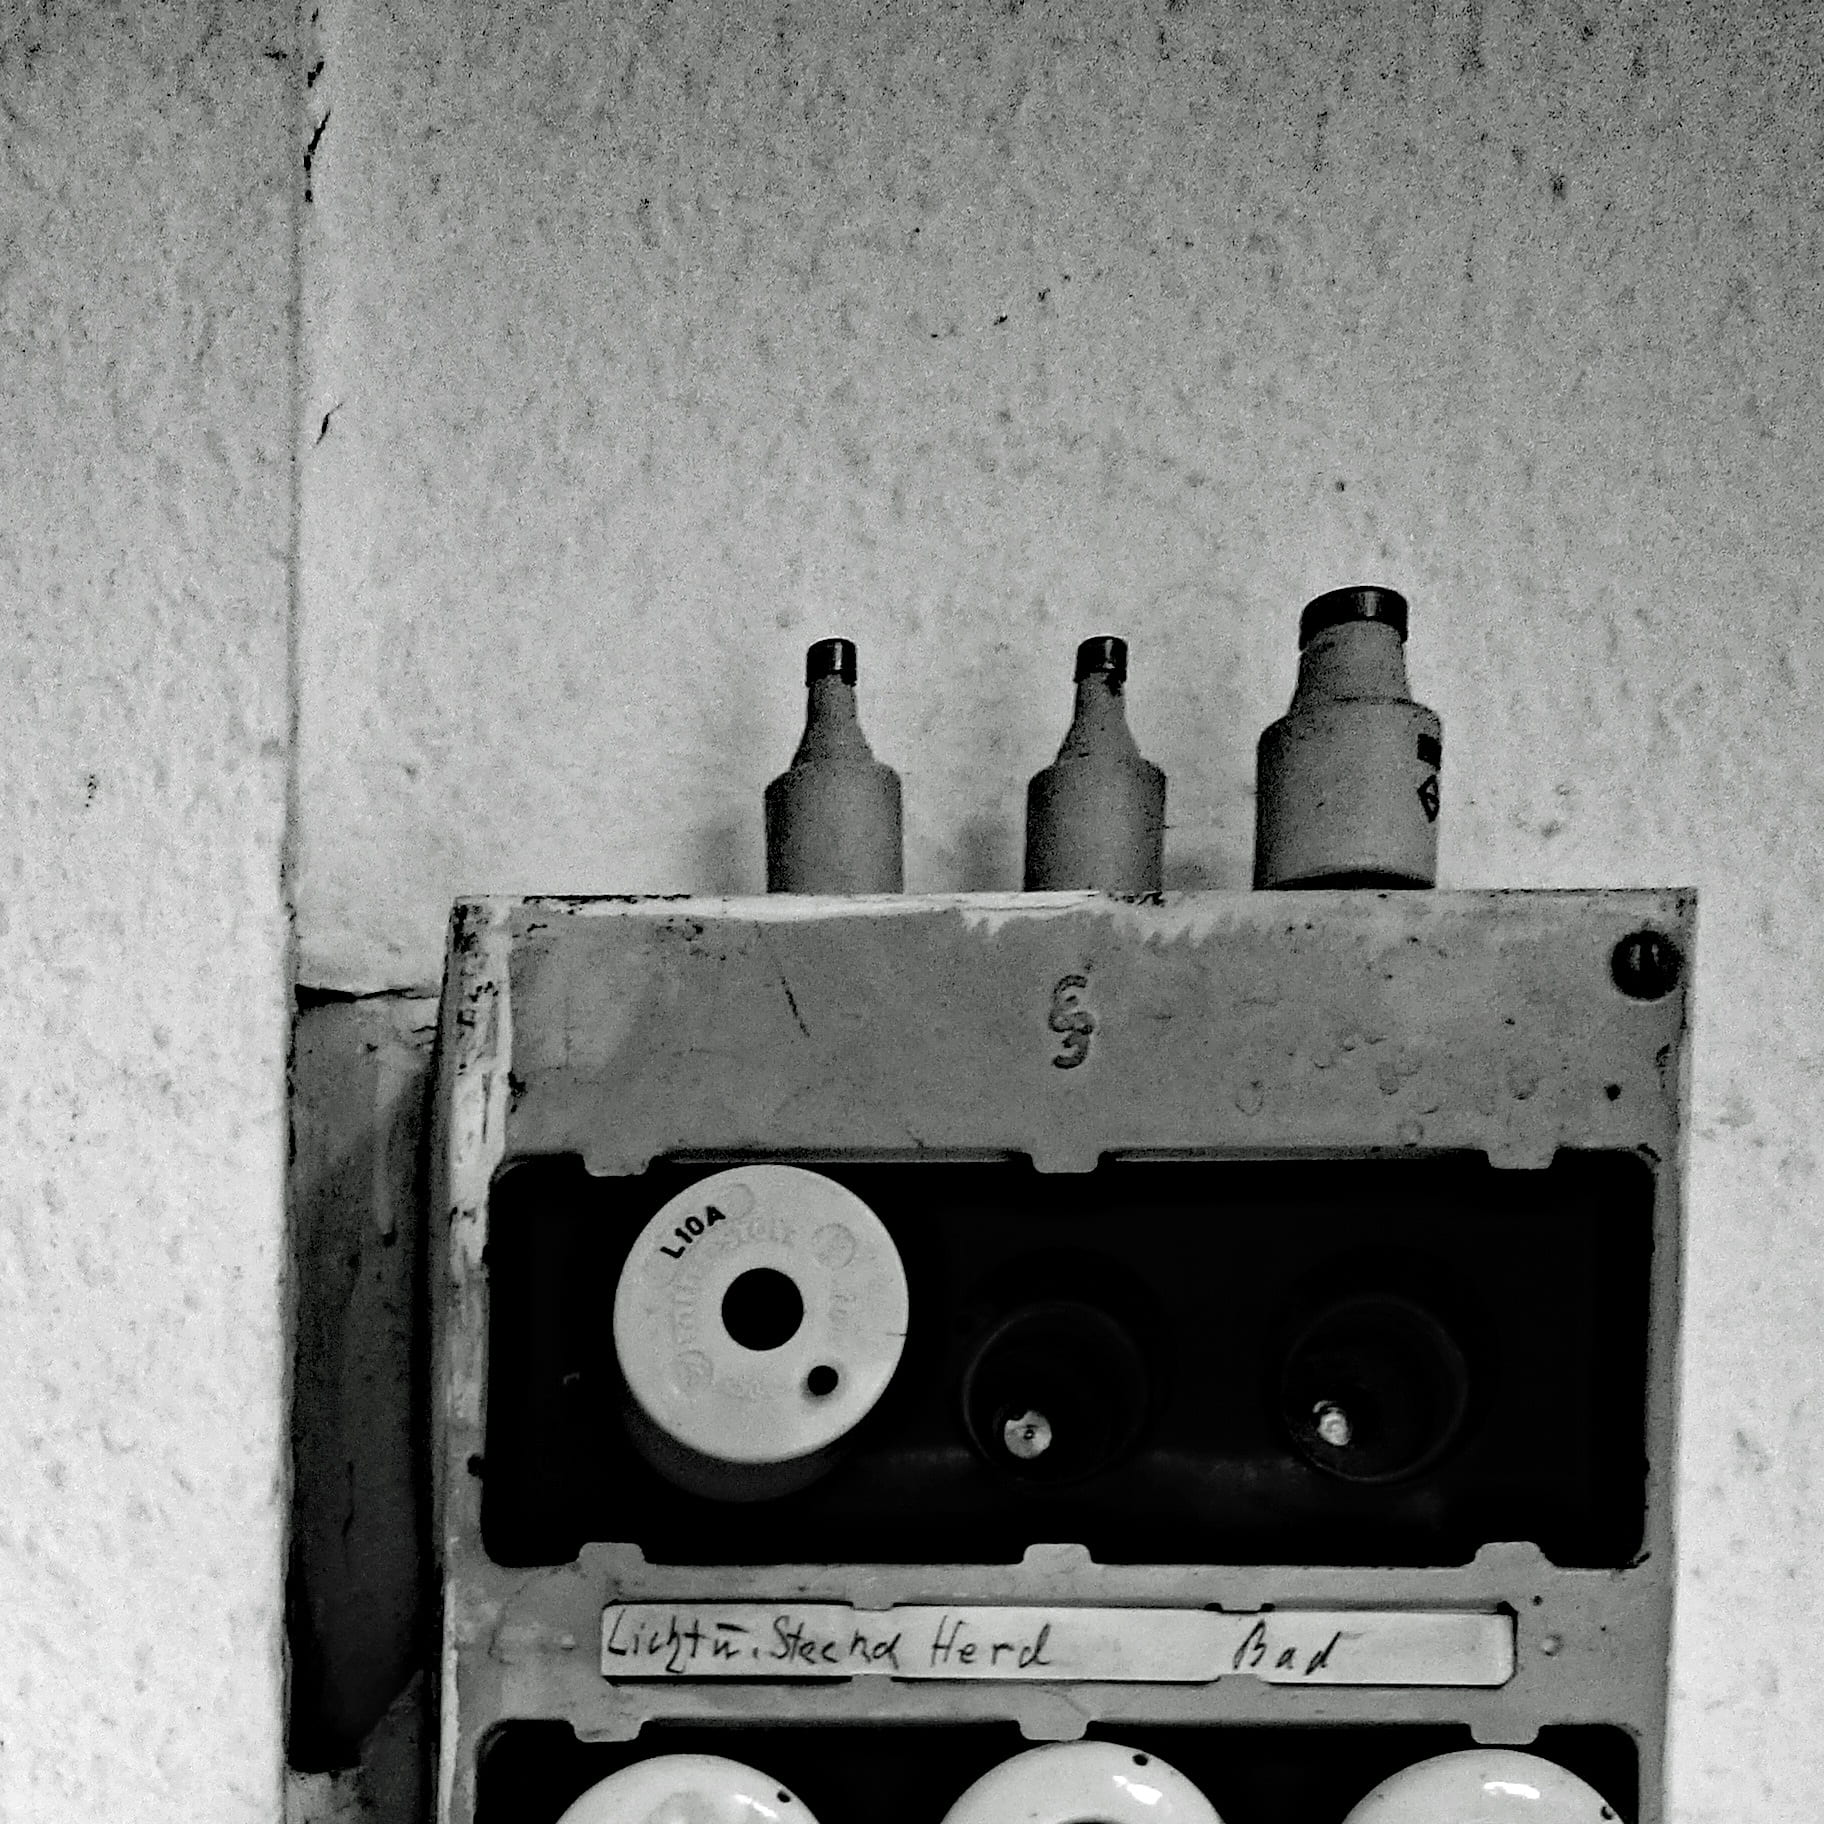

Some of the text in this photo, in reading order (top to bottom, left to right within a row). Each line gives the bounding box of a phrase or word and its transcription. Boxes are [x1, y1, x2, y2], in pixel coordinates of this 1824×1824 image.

[660, 1205, 726, 1260] L10A
[930, 1614, 1052, 1668] Herd
[1232, 1619, 1344, 1676] Bad
